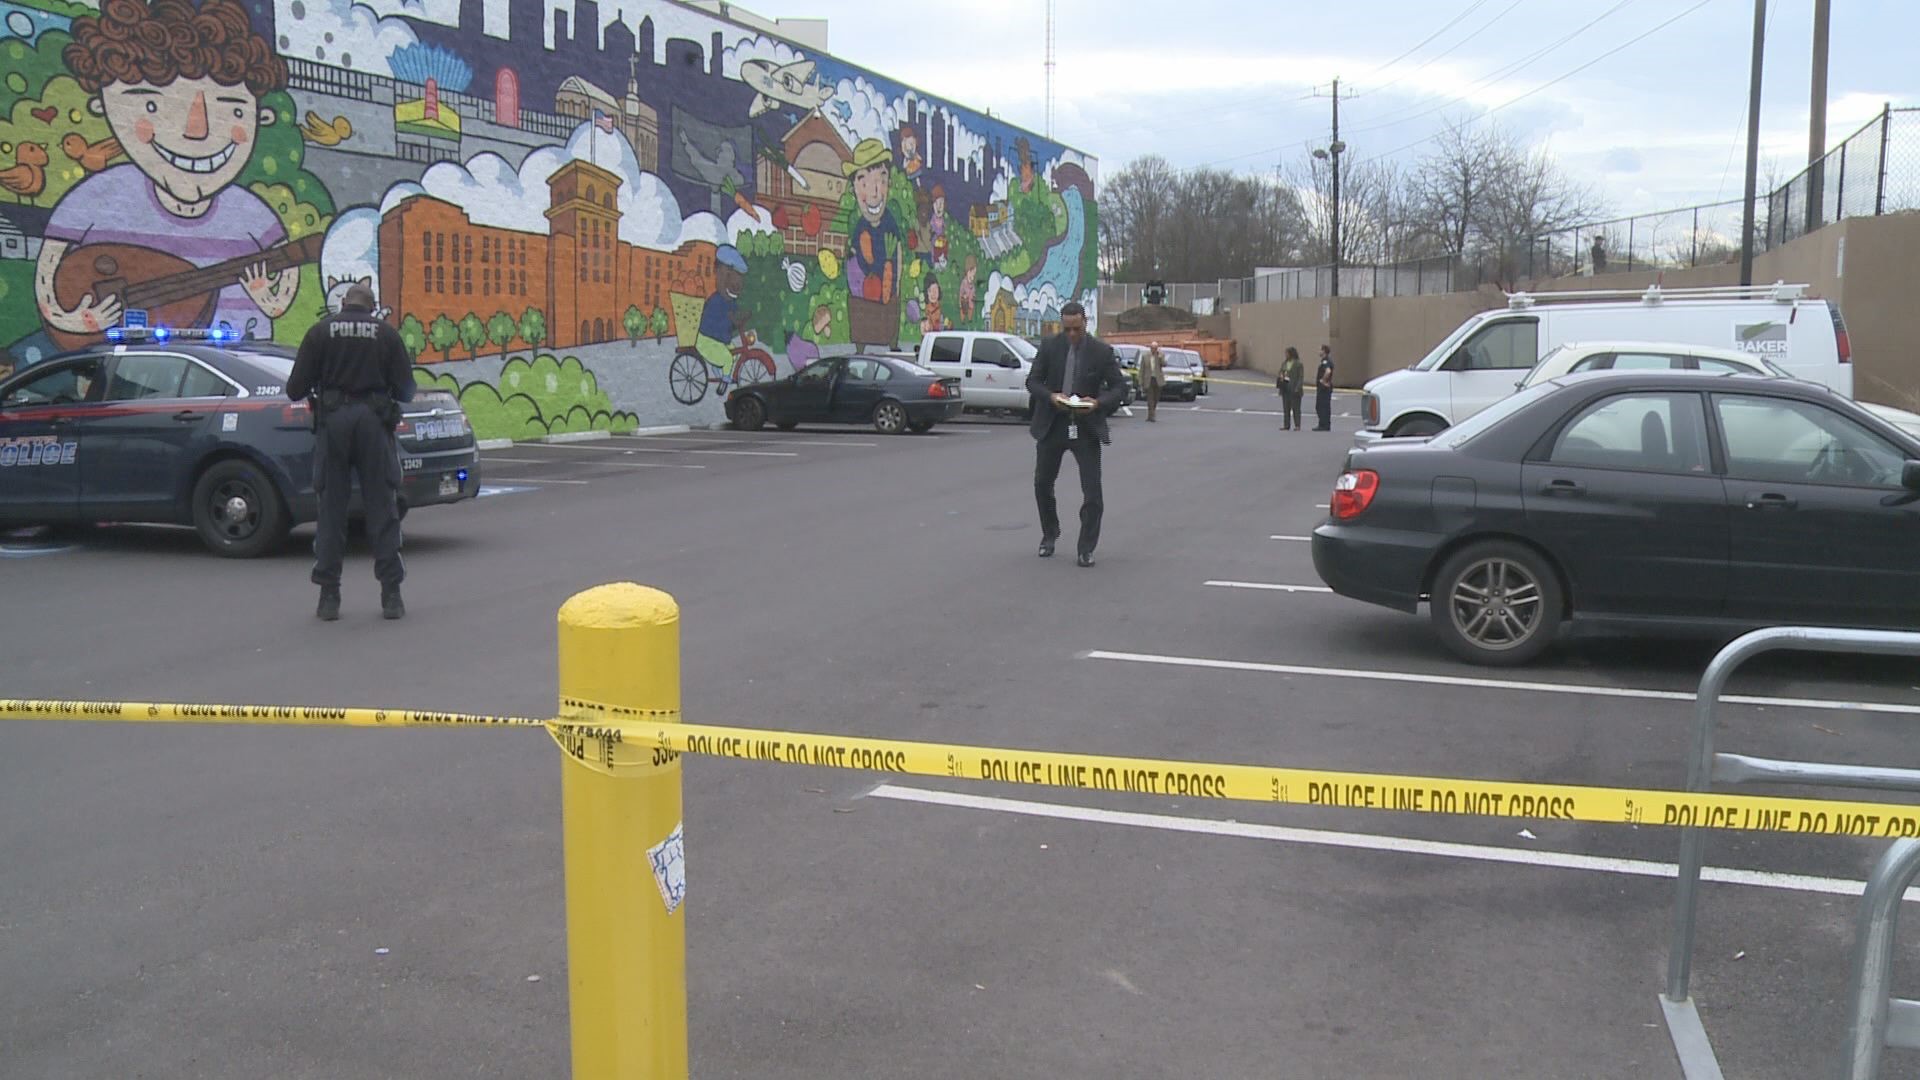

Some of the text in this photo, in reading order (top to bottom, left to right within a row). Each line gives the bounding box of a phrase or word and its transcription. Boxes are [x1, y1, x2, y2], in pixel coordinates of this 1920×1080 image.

[330, 321, 379, 339] POLICE
[1735, 340, 1787, 353] BAKER
[0, 442, 77, 466] OLICE
[687, 735, 741, 757] POLICE
[786, 743, 808, 764] DO
[813, 745, 845, 767] NOT
[850, 748, 906, 772] CROSS
[981, 759, 1041, 784] POLICE
[1093, 767, 1117, 790] DO
[1123, 769, 1158, 793] NOT
[1164, 772, 1226, 797] CROSS
[1308, 782, 1375, 808] POLICE
[1431, 790, 1456, 813] DO
[1464, 792, 1503, 816] NOT
[1508, 795, 1575, 820] CROSS
[1664, 804, 1738, 828] POLICE
[1797, 811, 1828, 833] DO
[1834, 814, 1880, 836] NOT
